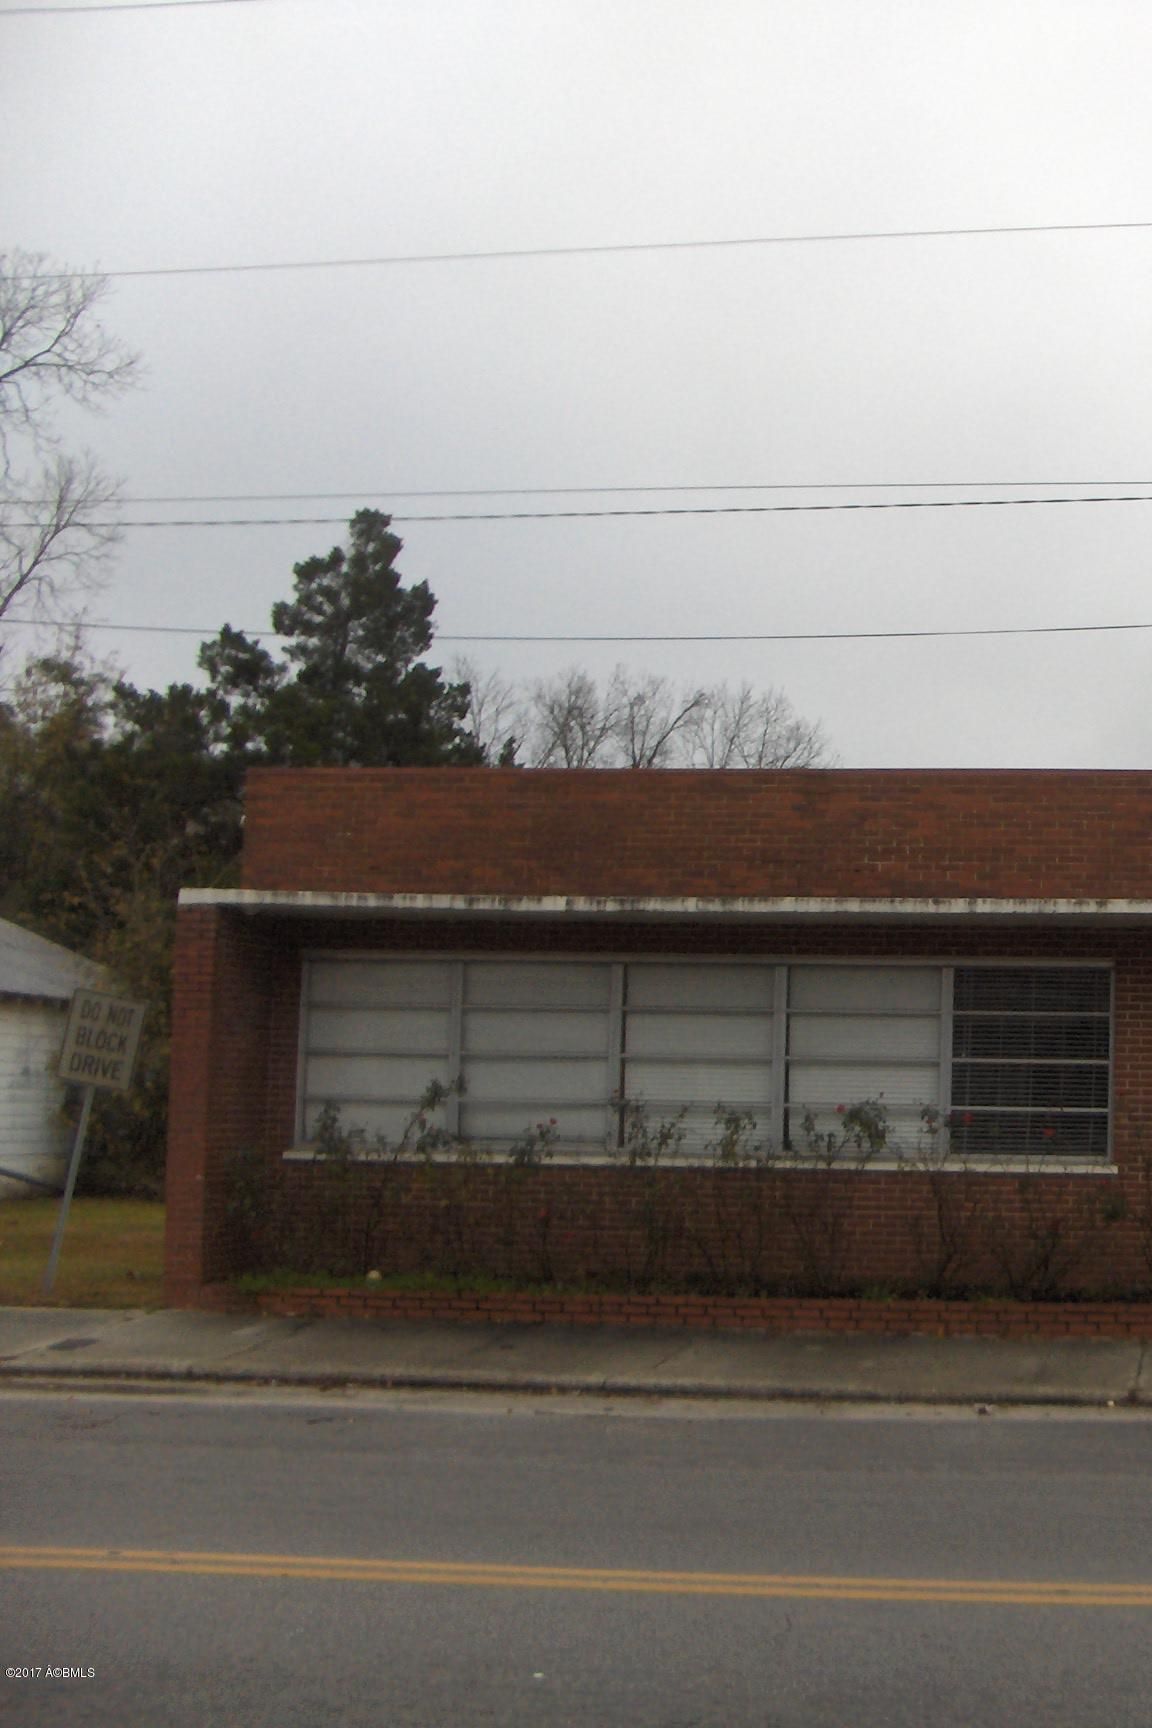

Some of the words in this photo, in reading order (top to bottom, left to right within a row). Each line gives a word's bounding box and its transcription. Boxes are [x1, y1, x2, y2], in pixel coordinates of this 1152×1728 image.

[80, 1000, 102, 1021] DO
[106, 1003, 134, 1026] NOT
[75, 1025, 128, 1054] BLOCK
[70, 1052, 124, 1080] DRIVE
